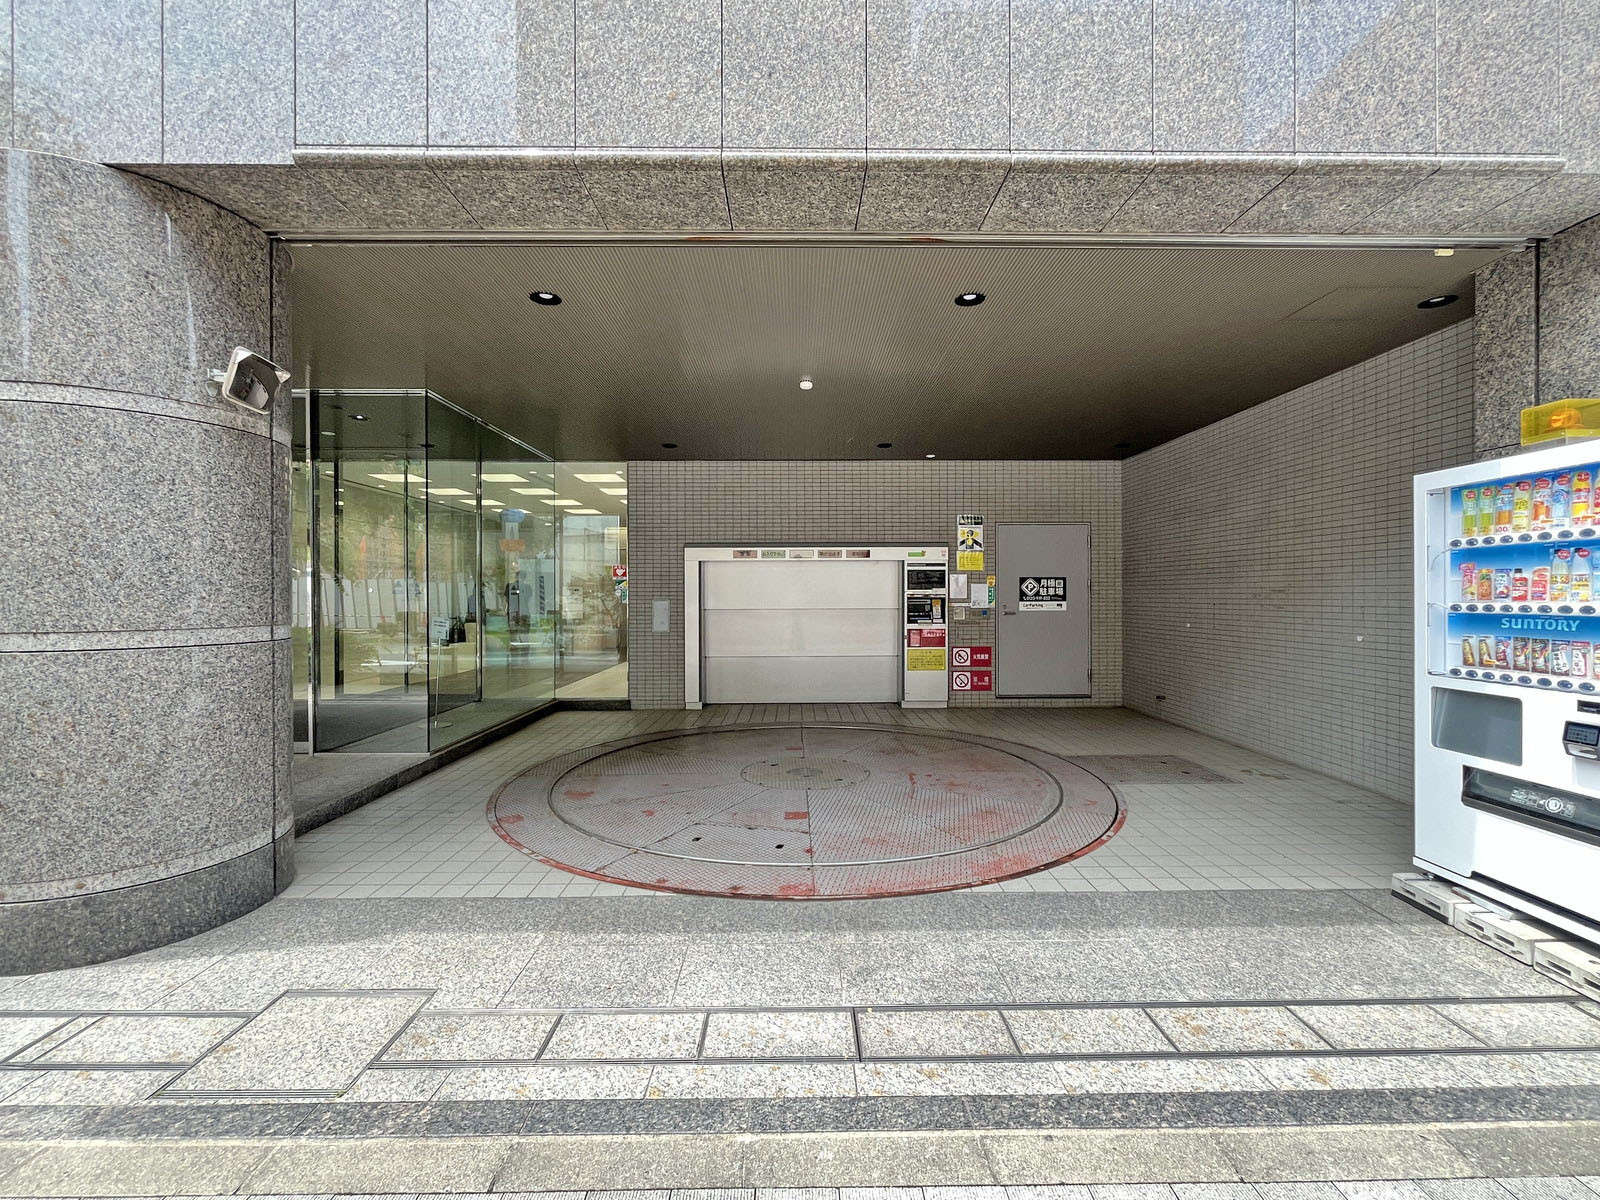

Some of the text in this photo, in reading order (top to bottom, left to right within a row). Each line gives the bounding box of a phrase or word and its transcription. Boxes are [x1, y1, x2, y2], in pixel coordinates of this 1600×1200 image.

[1039, 587, 1064, 596] 駐車場
[1500, 617, 1580, 631] SUNTORY
